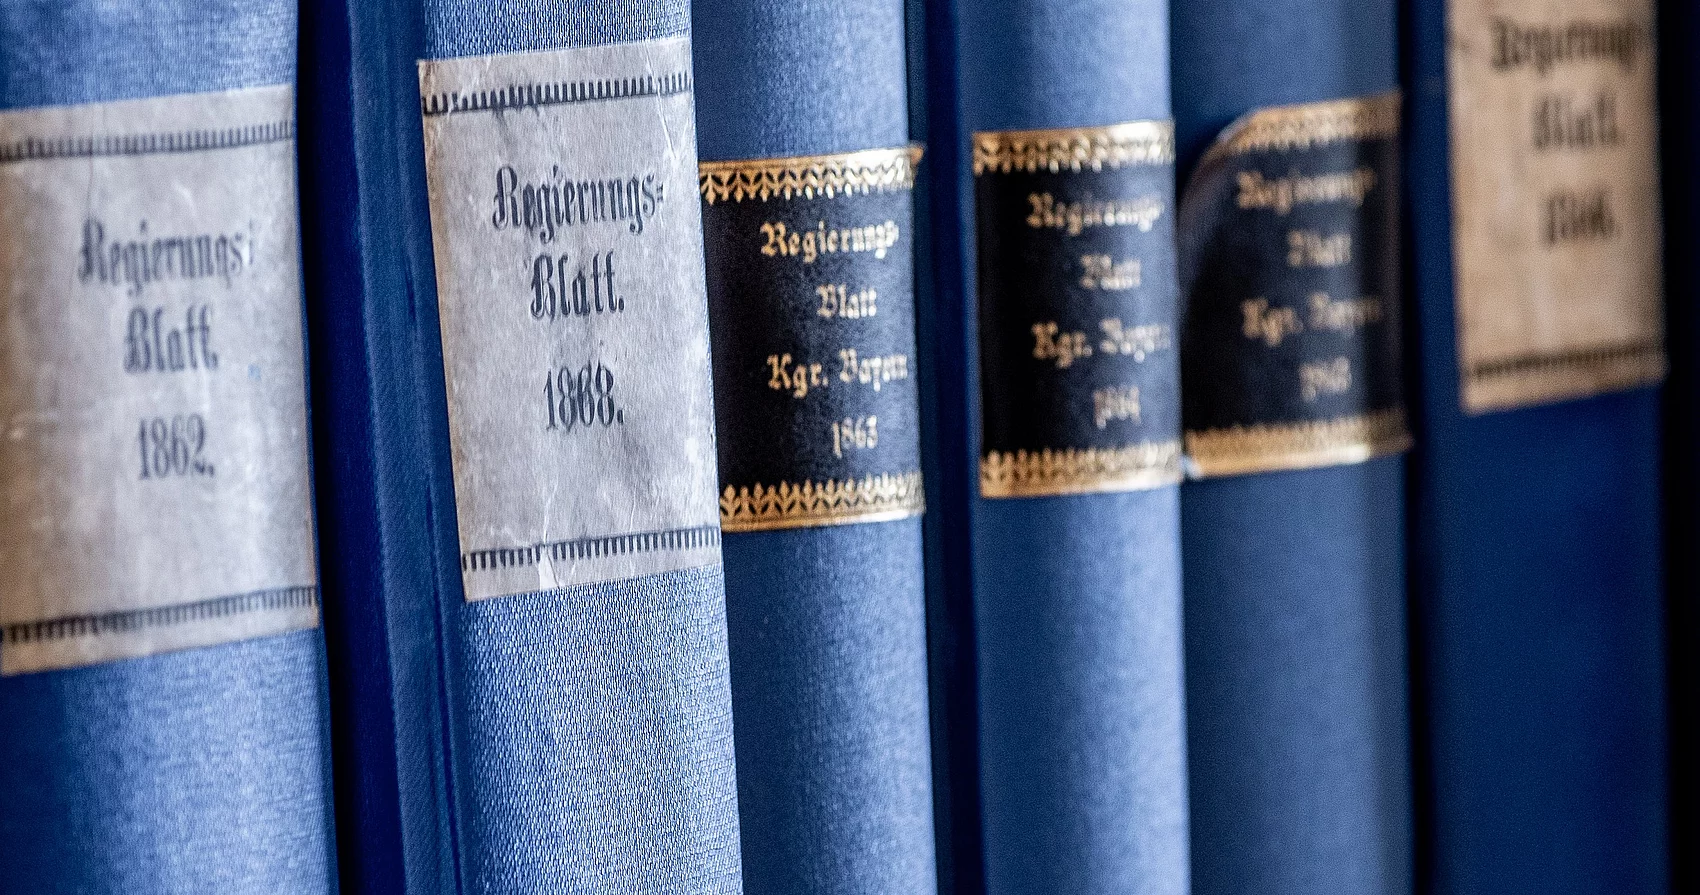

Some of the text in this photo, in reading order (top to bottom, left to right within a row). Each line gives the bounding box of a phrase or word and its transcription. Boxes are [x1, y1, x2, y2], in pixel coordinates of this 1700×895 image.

[530, 251, 625, 322] Blatt.
[816, 283, 877, 319] Blatt
[124, 304, 219, 373] Blatt.
[543, 361, 625, 434] 1868.
[766, 352, 829, 399] Kgr.
[138, 412, 216, 480] 1862.
